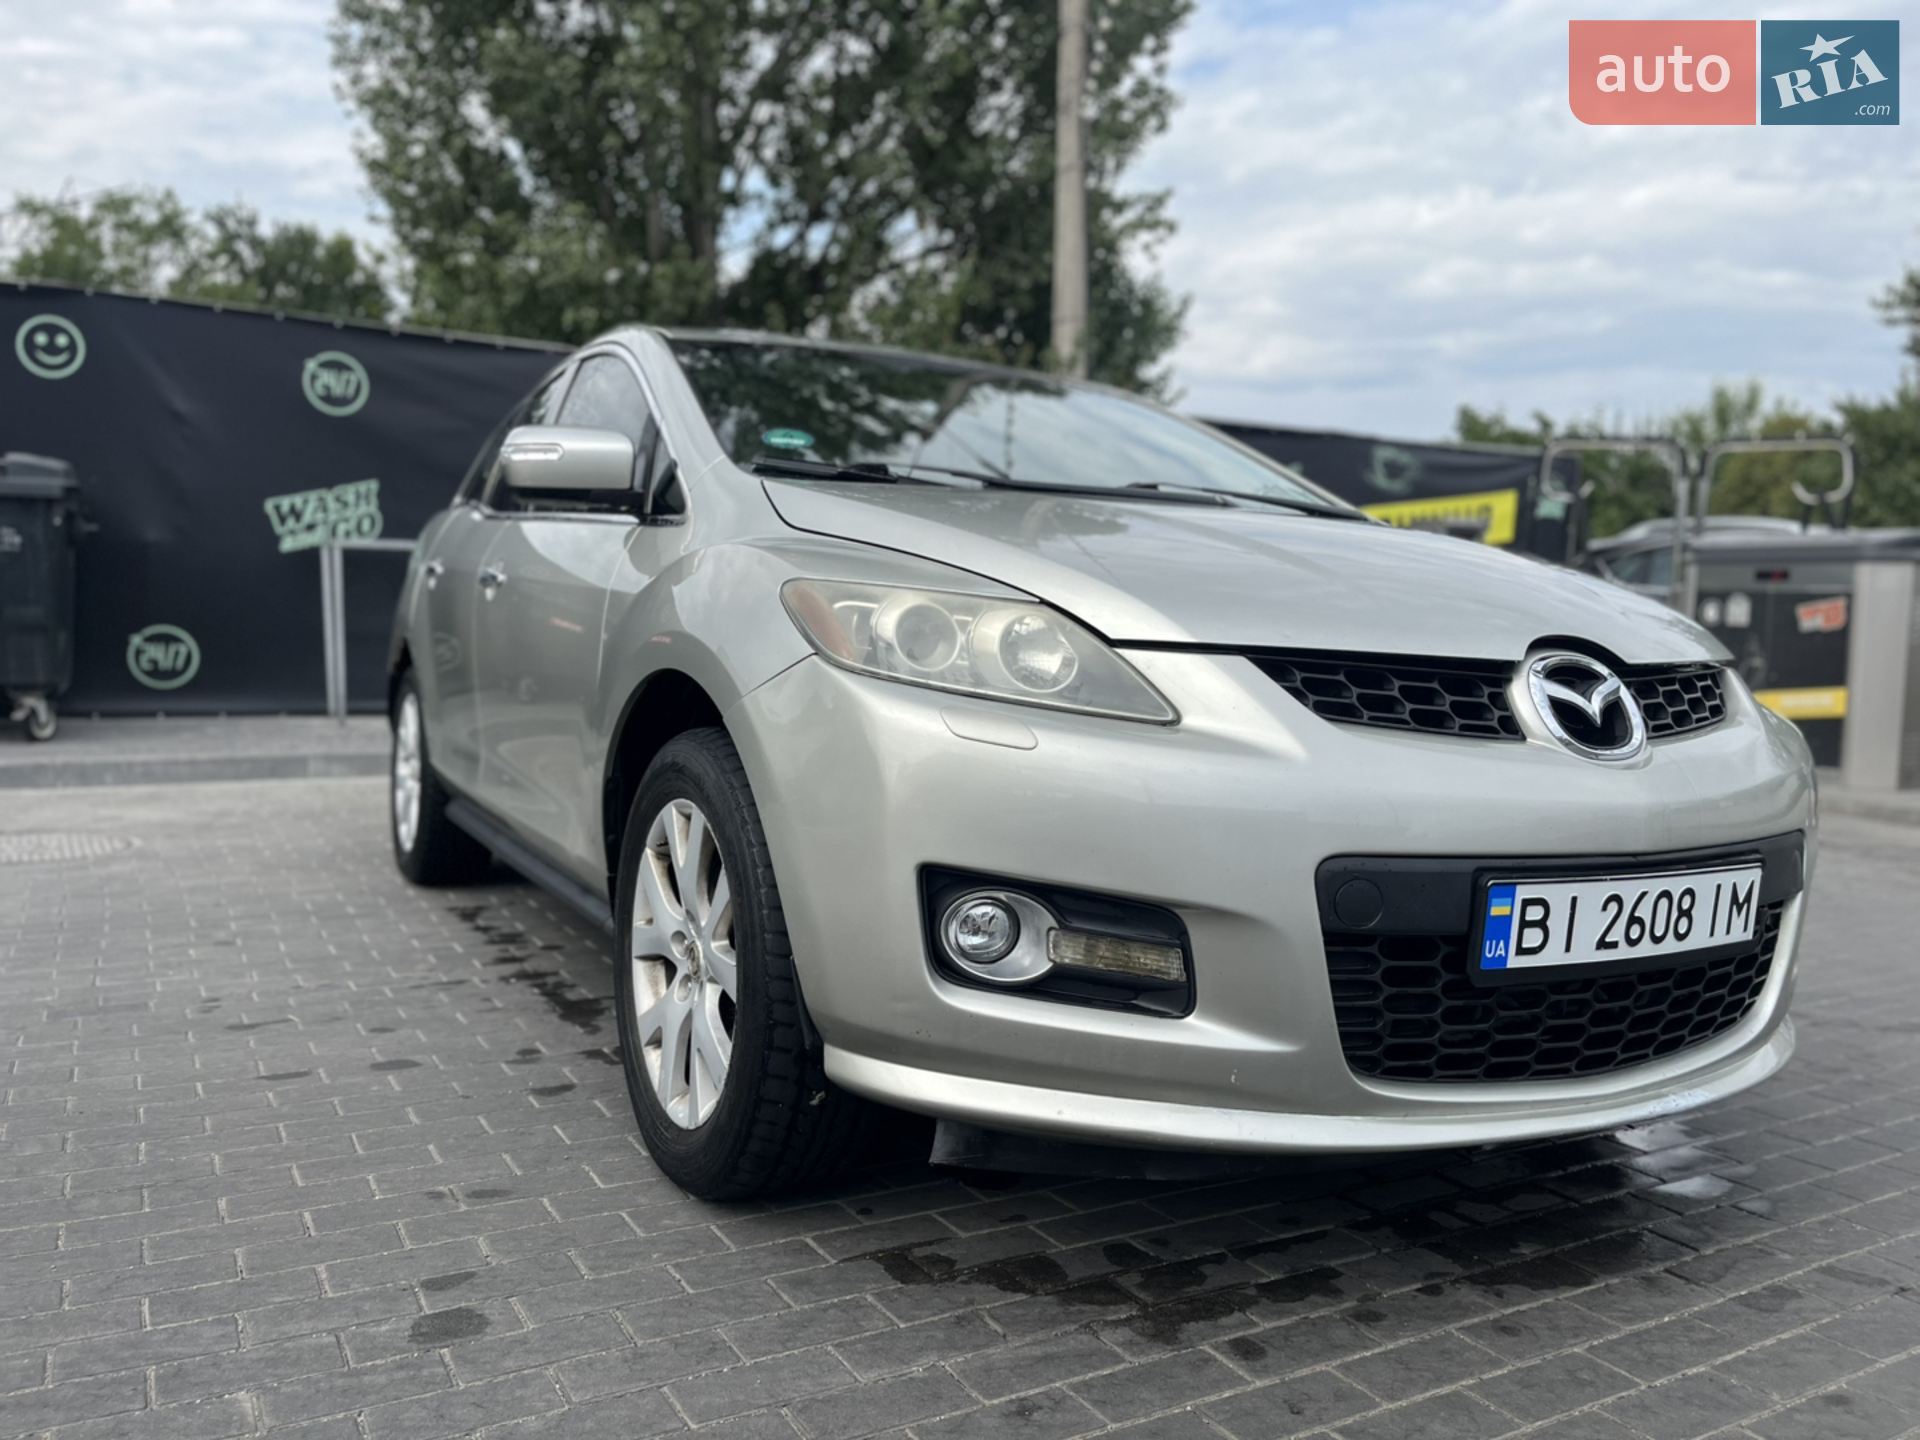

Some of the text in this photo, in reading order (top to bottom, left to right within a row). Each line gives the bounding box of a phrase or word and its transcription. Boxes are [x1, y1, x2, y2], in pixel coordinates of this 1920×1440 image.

[1594, 886, 1697, 952] 2608
[1708, 879, 1756, 939] IM
[1485, 940, 1506, 958] UA
